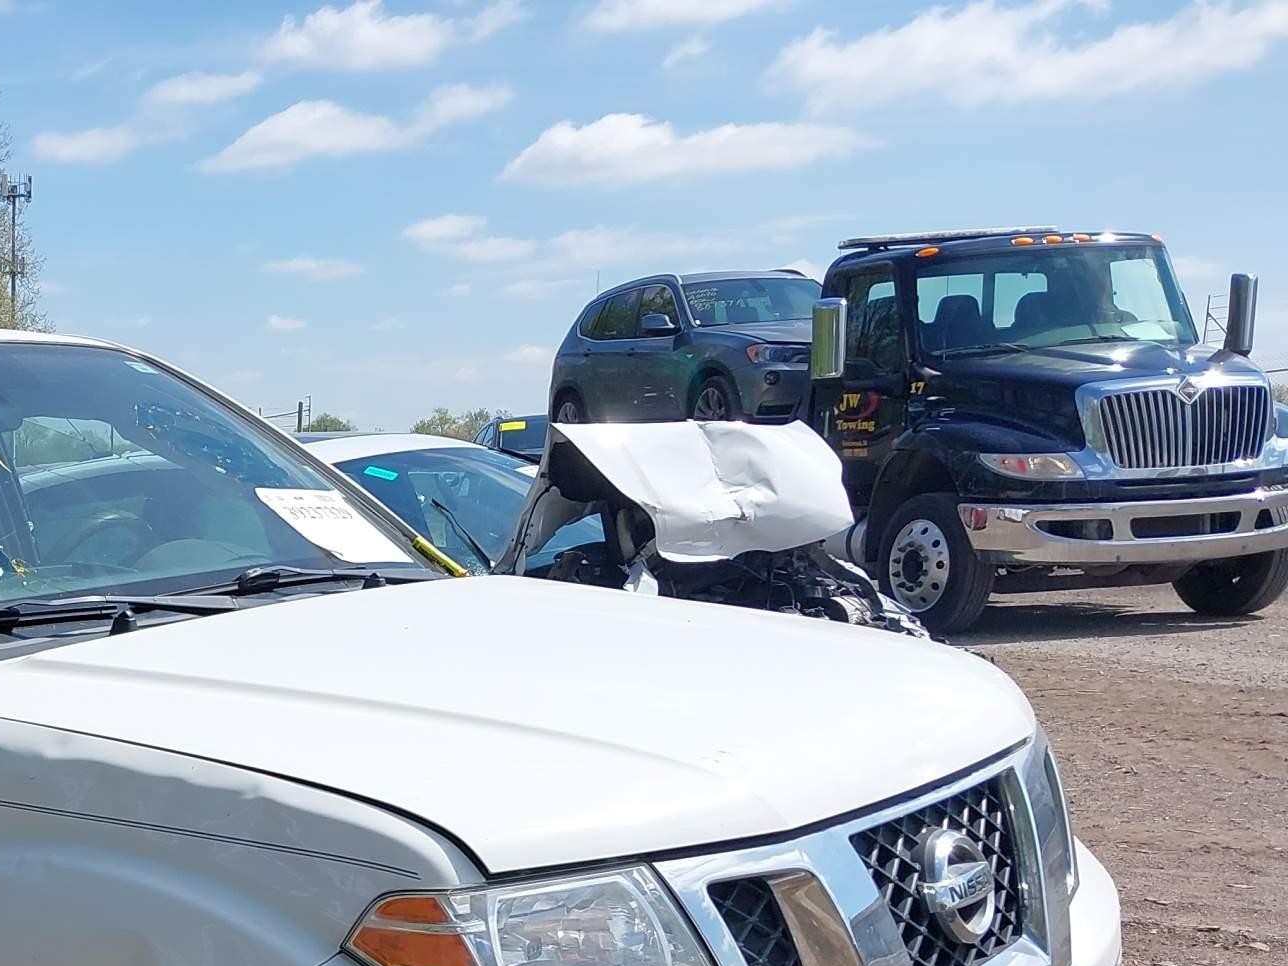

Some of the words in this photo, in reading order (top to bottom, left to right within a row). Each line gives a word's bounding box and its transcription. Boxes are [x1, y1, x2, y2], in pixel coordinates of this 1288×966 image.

[909, 381, 925, 395] 17
[839, 393, 861, 412] JW
[835, 419, 876, 432] Towing
